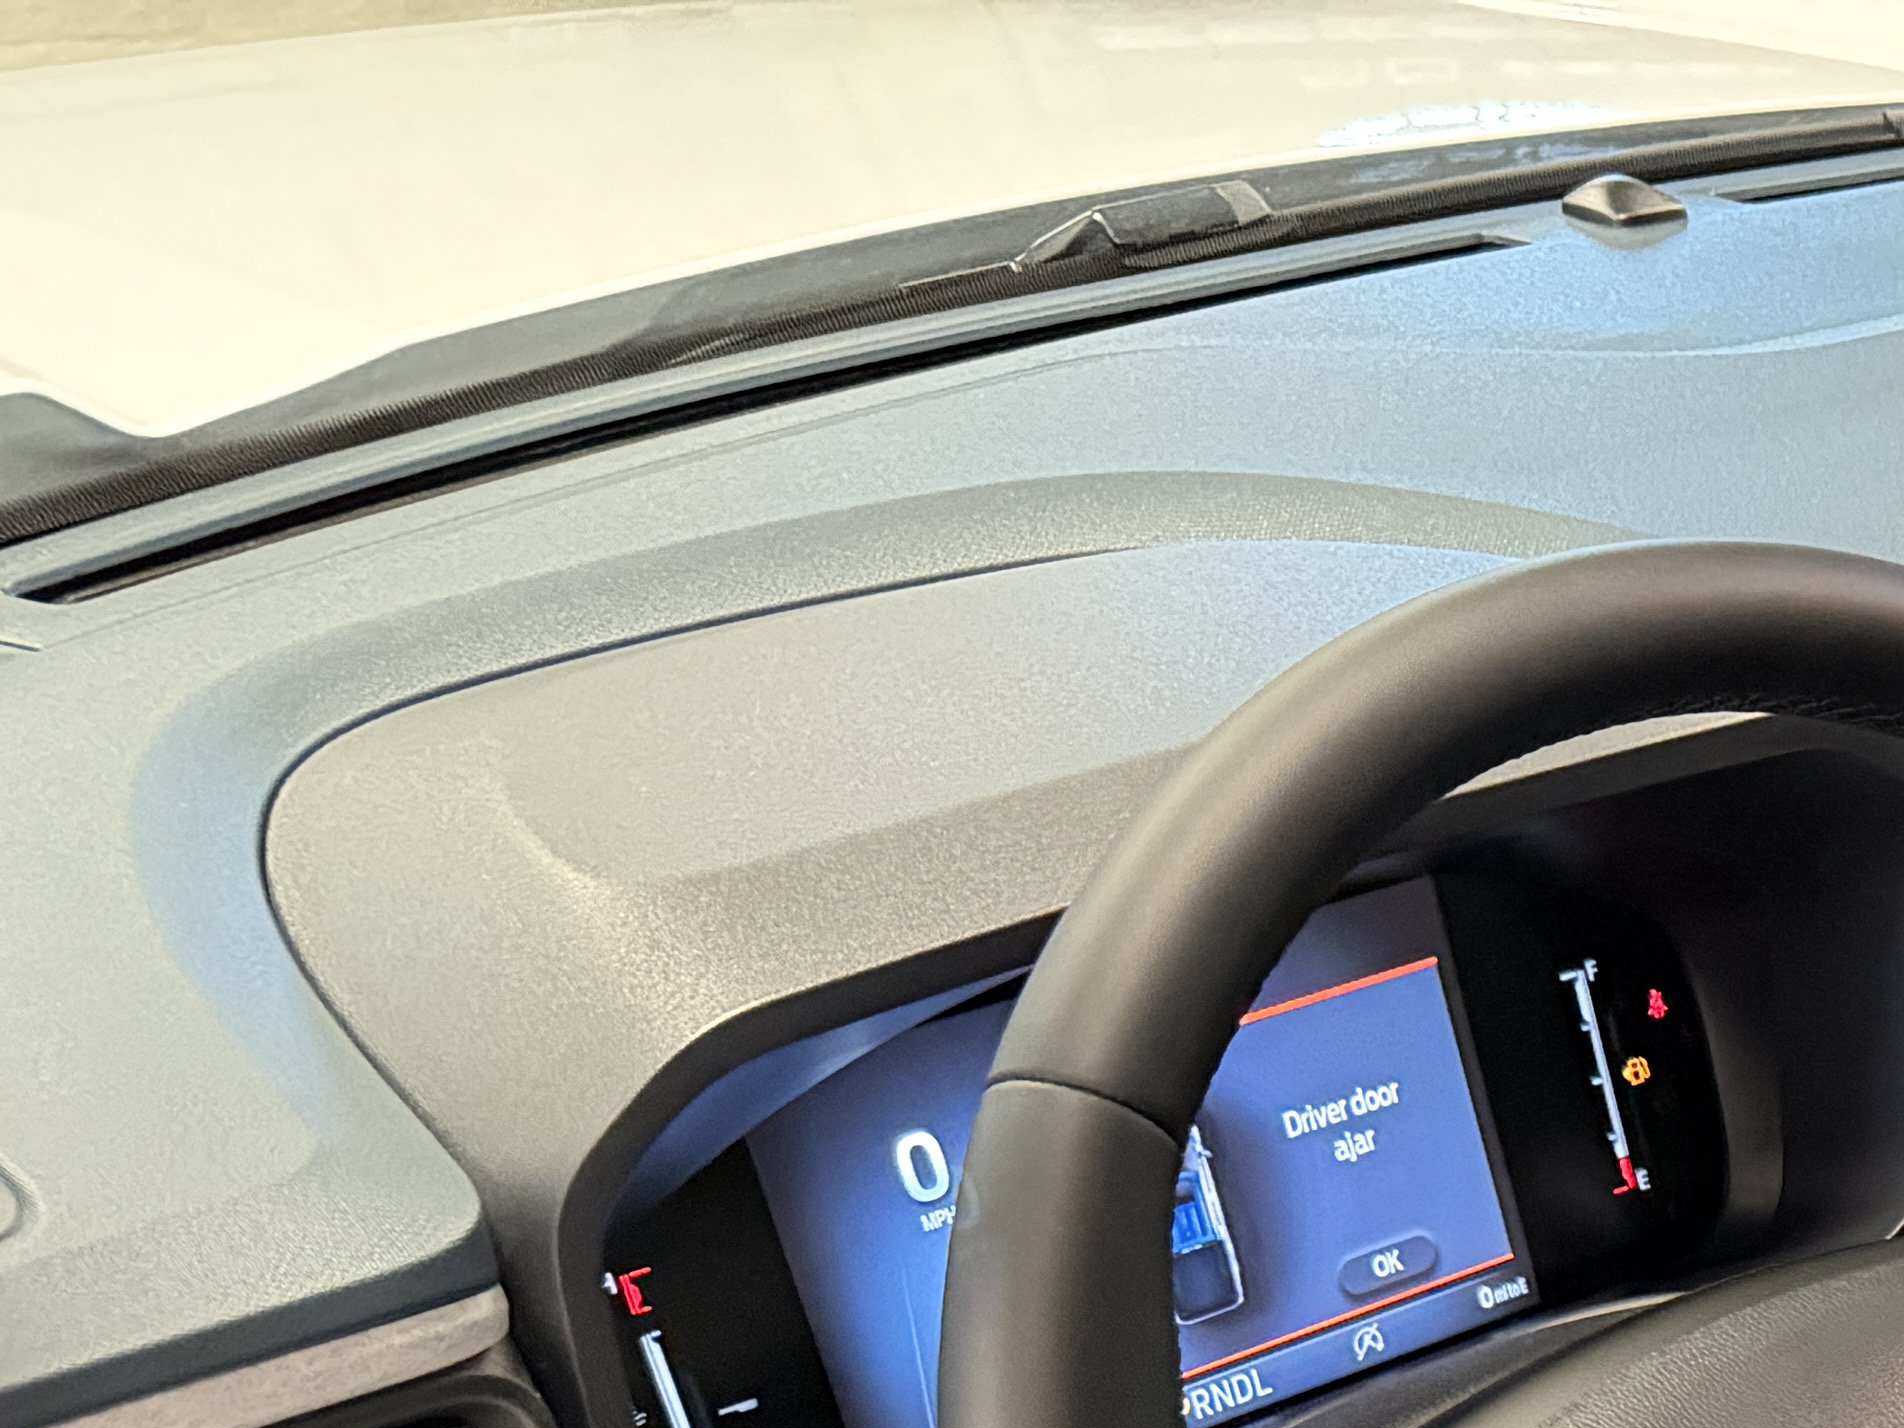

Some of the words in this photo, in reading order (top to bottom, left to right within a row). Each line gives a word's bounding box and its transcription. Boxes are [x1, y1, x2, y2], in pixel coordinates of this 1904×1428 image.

[1584, 957, 1598, 983] F
[1282, 1098, 1348, 1140] Driver
[1351, 1081, 1401, 1118] door
[1333, 1128, 1376, 1164] ajar
[895, 1129, 952, 1203] 0
[1636, 1169, 1652, 1191] E
[1371, 1247, 1405, 1280] OK
